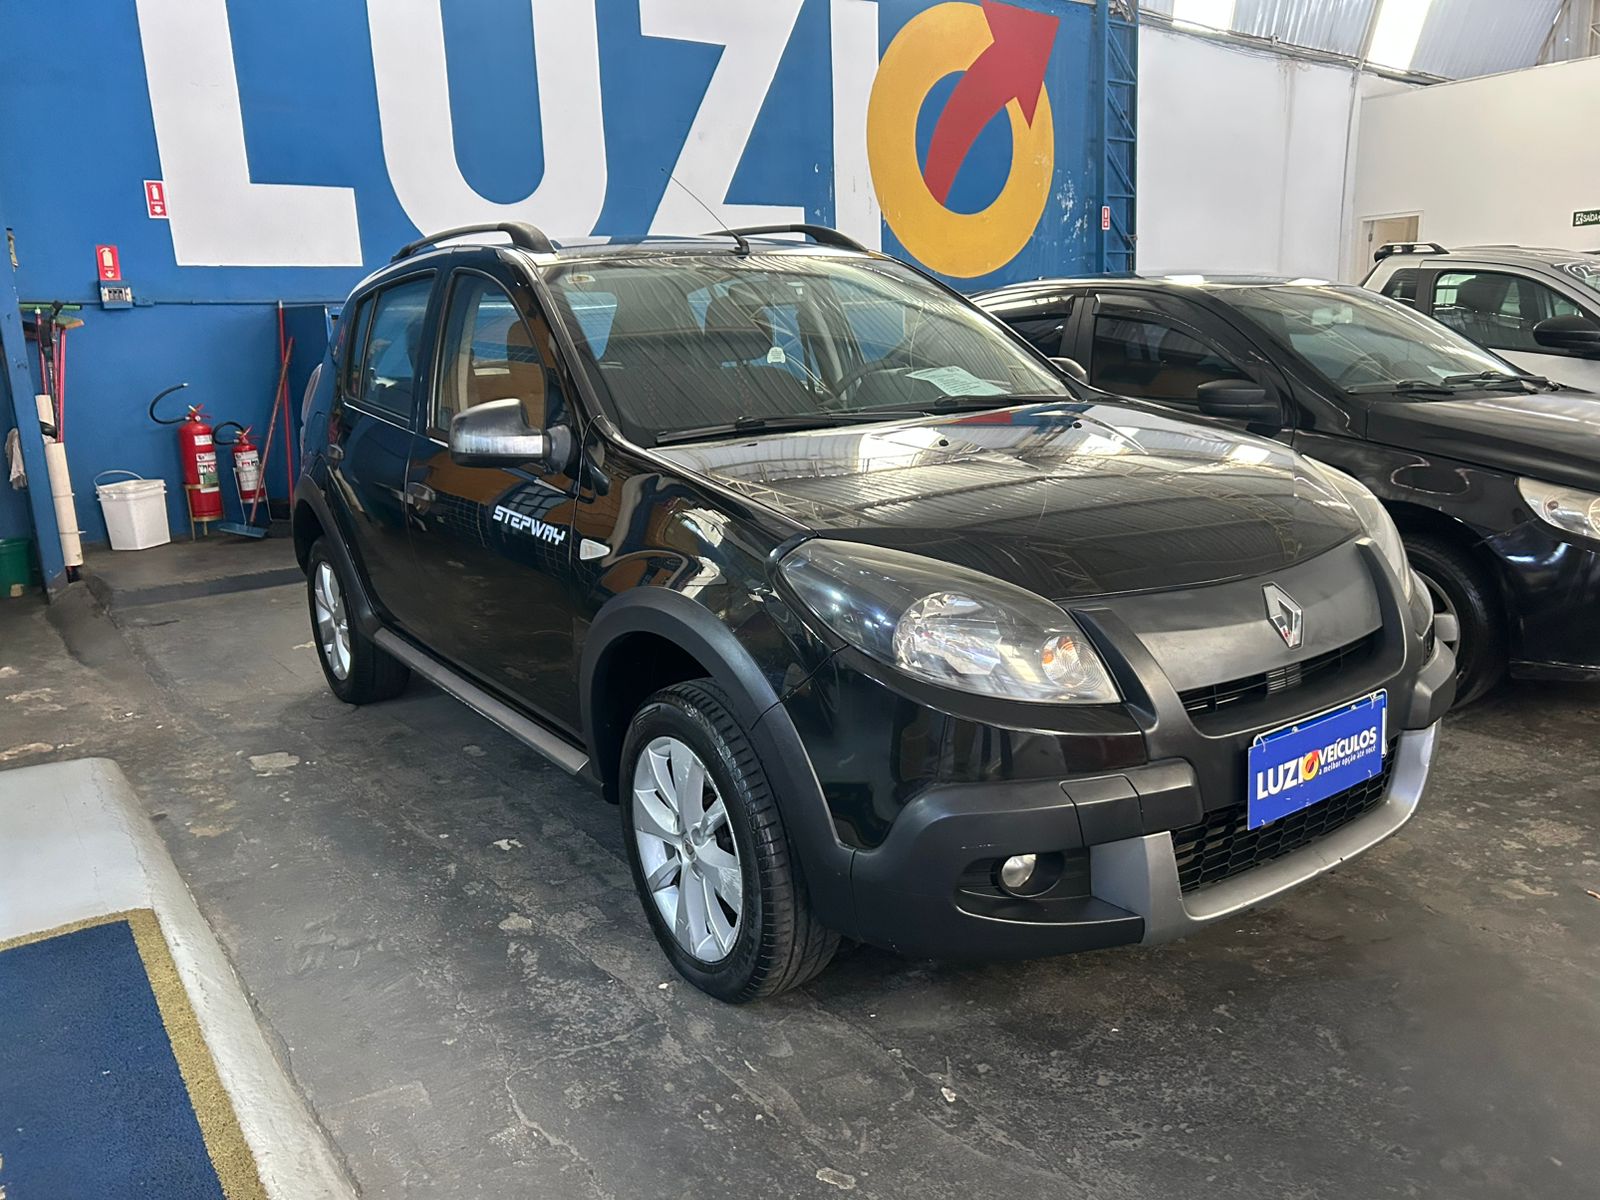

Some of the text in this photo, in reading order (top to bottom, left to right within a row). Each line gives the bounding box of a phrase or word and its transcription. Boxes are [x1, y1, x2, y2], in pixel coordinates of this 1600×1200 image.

[135, 0, 1058, 278] LUZIO
[492, 504, 566, 546] STEPWAY
[1319, 726, 1377, 766] VEÍCULOS
[1323, 760, 1341, 774] melhor
[1341, 753, 1356, 766] opção
